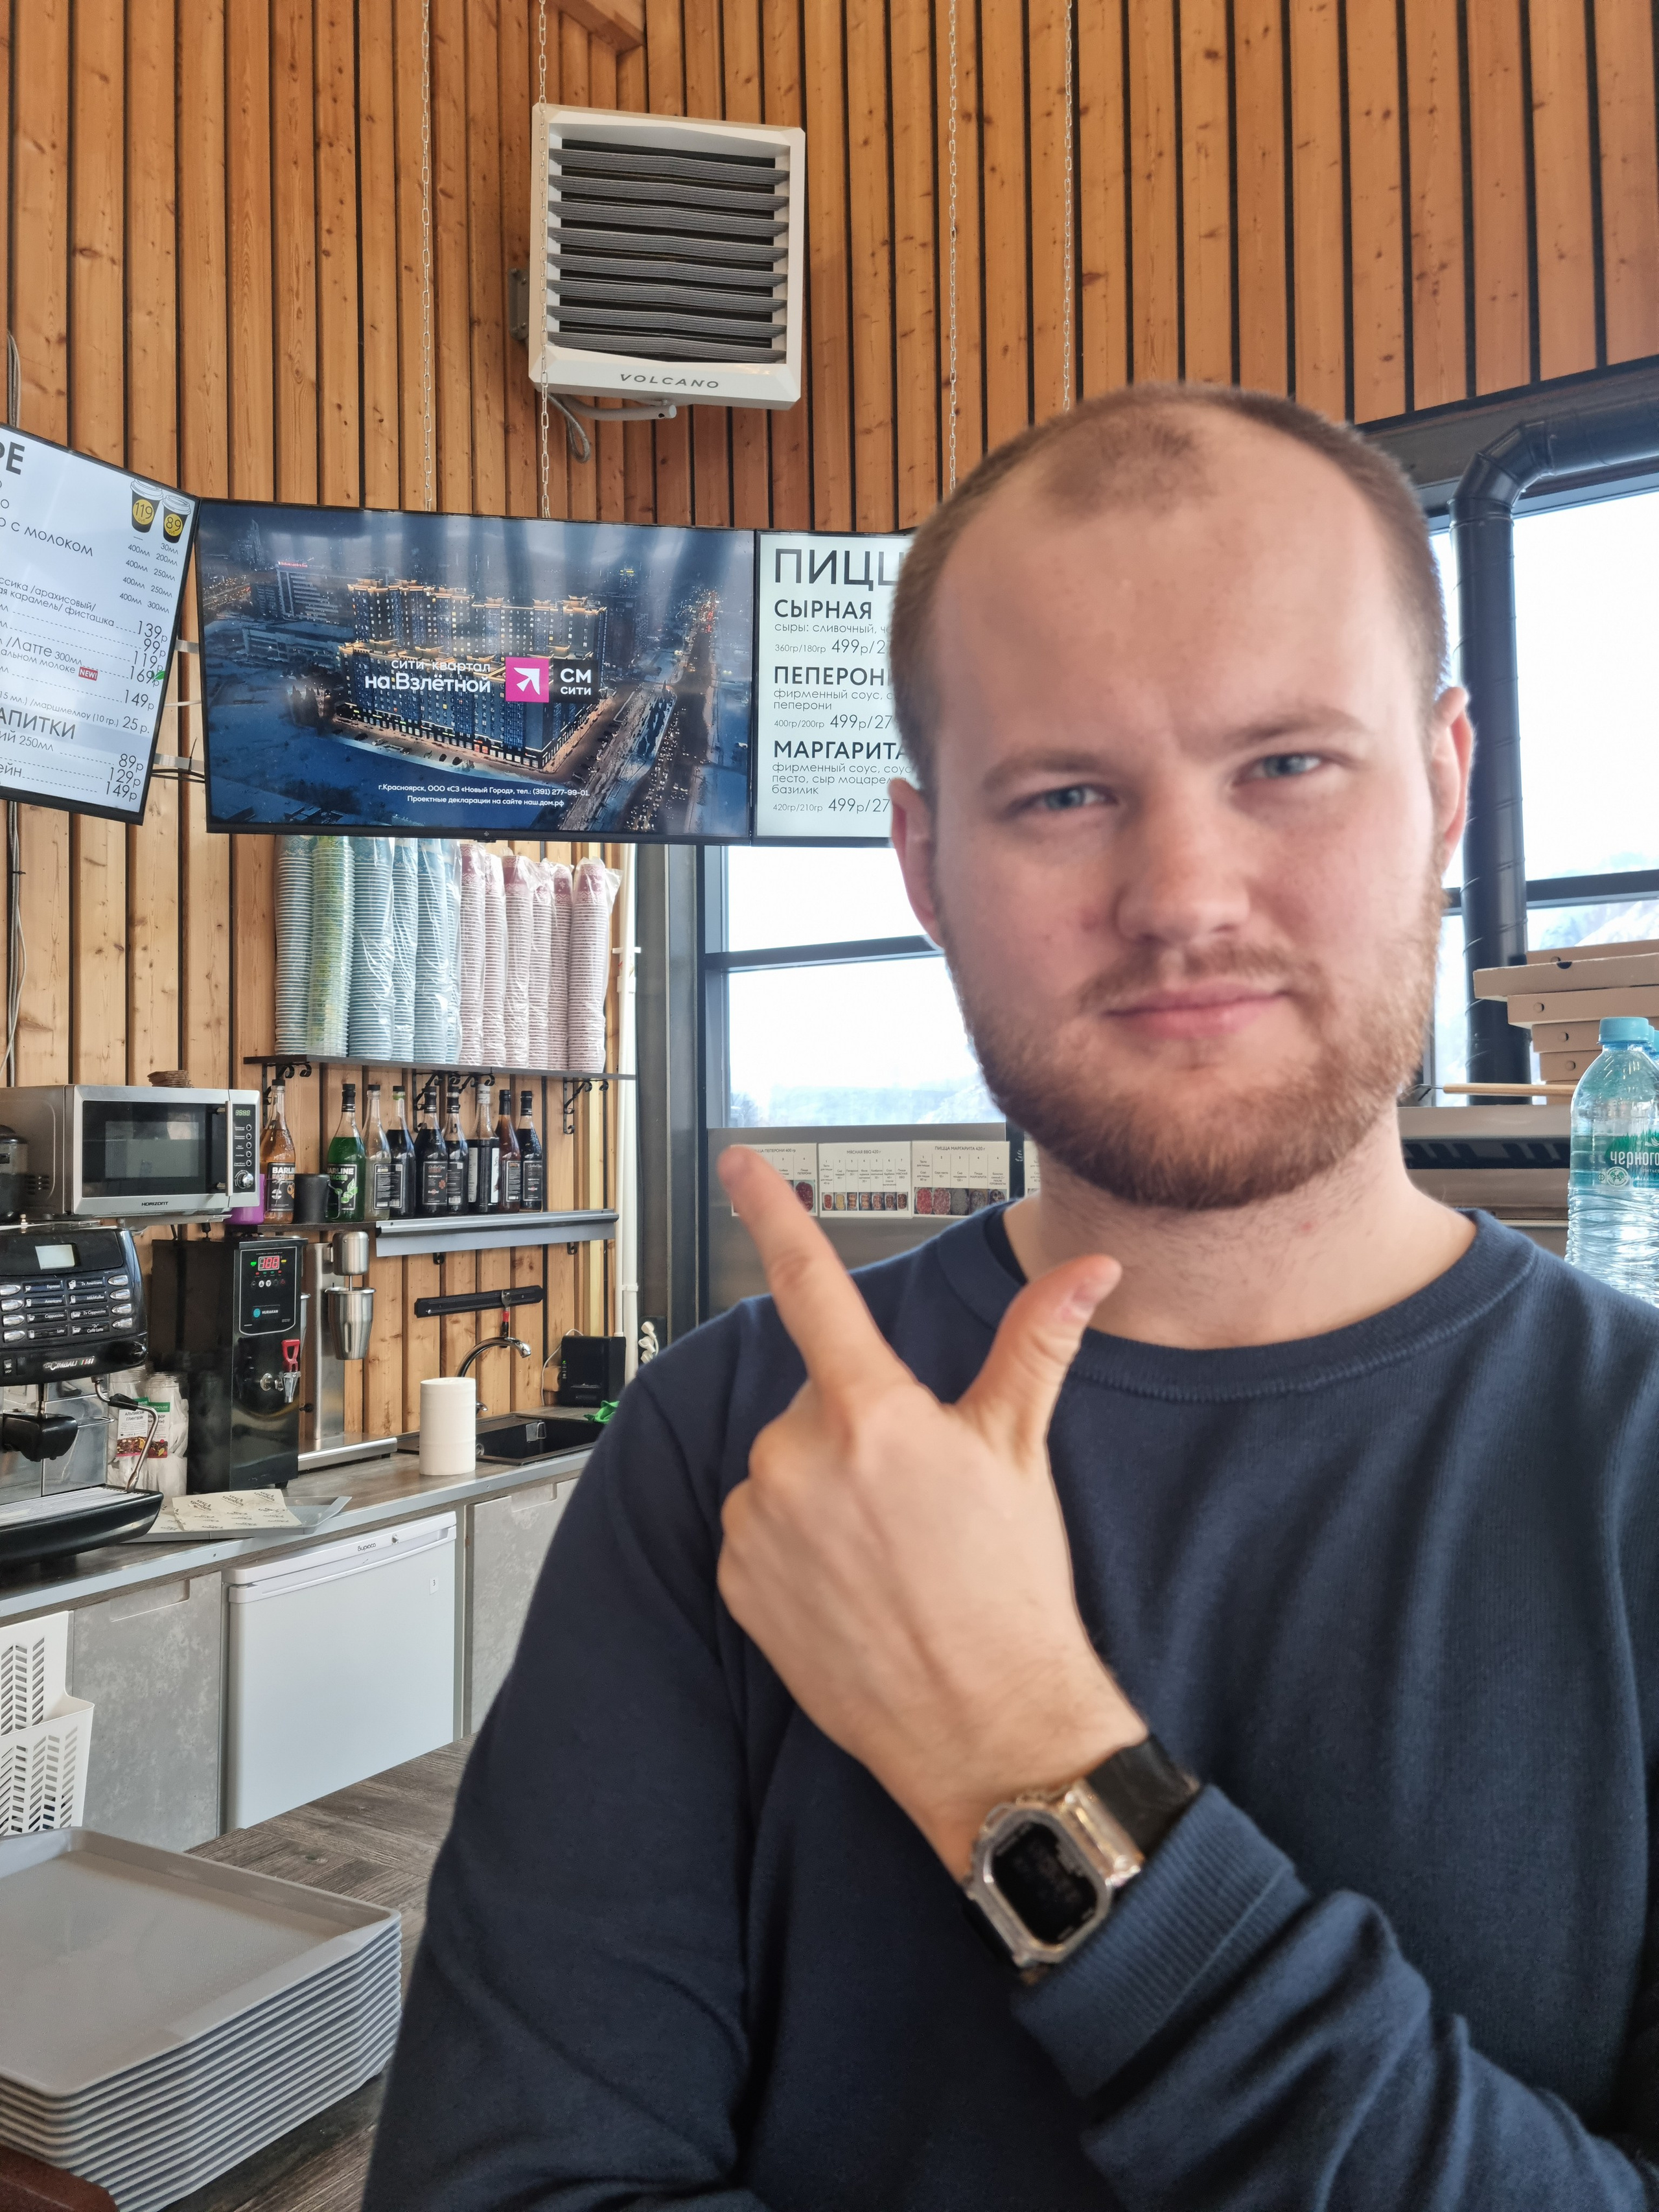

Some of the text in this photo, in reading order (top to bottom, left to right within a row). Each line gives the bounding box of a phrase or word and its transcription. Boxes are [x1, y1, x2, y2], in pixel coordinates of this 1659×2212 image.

[620, 373, 719, 389] VOLCANO
[135, 502, 153, 519] 119
[166, 517, 181, 531] 89
[24, 526, 93, 557] молоком
[160, 542, 179, 555] 30мл
[128, 544, 178, 566] 400мл 200мл
[126, 559, 176, 581] 400мл 250мл
[775, 548, 905, 592] ПИЦЦ
[122, 576, 145, 589] 400мл
[150, 585, 173, 598] 250мл
[119, 592, 170, 614] 400мл 300мл
[774, 599, 872, 620] СЫРНАЯ
[65, 606, 115, 627] фисташка
[774, 623, 877, 634] сыры: сливочный,
[774, 644, 827, 654] 360гр/180гр
[54, 651, 82, 666] 300мл
[39, 659, 76, 674] молоке
[79, 668, 98, 680] NEW!
[365, 671, 491, 693] на Взлётной
[560, 667, 592, 684] СМ
[560, 686, 592, 696] сити
[773, 688, 848, 700] фирменный
[851, 691, 883, 702] соус,
[124, 690, 155, 711] 149р
[773, 701, 832, 712] пеперони
[122, 716, 139, 730] 25
[774, 719, 825, 729] 400гр/200гр
[19, 735, 54, 752] 250мл
[774, 740, 907, 760] МАРГАРИТА
[119, 753, 144, 773] 89р
[772, 762, 846, 774] фирменный
[849, 765, 881, 775] соус,
[110, 767, 141, 788] 129р
[772, 774, 809, 785] песто,
[812, 776, 835, 786] сыр
[106, 781, 137, 802] 149р
[378, 784, 426, 792] г.Красноярск,
[771, 784, 819, 795] базилик
[407, 795, 447, 804] Проектные
[524, 799, 564, 808] наш.дом.рф
[772, 804, 823, 813] 420гр/210гр
